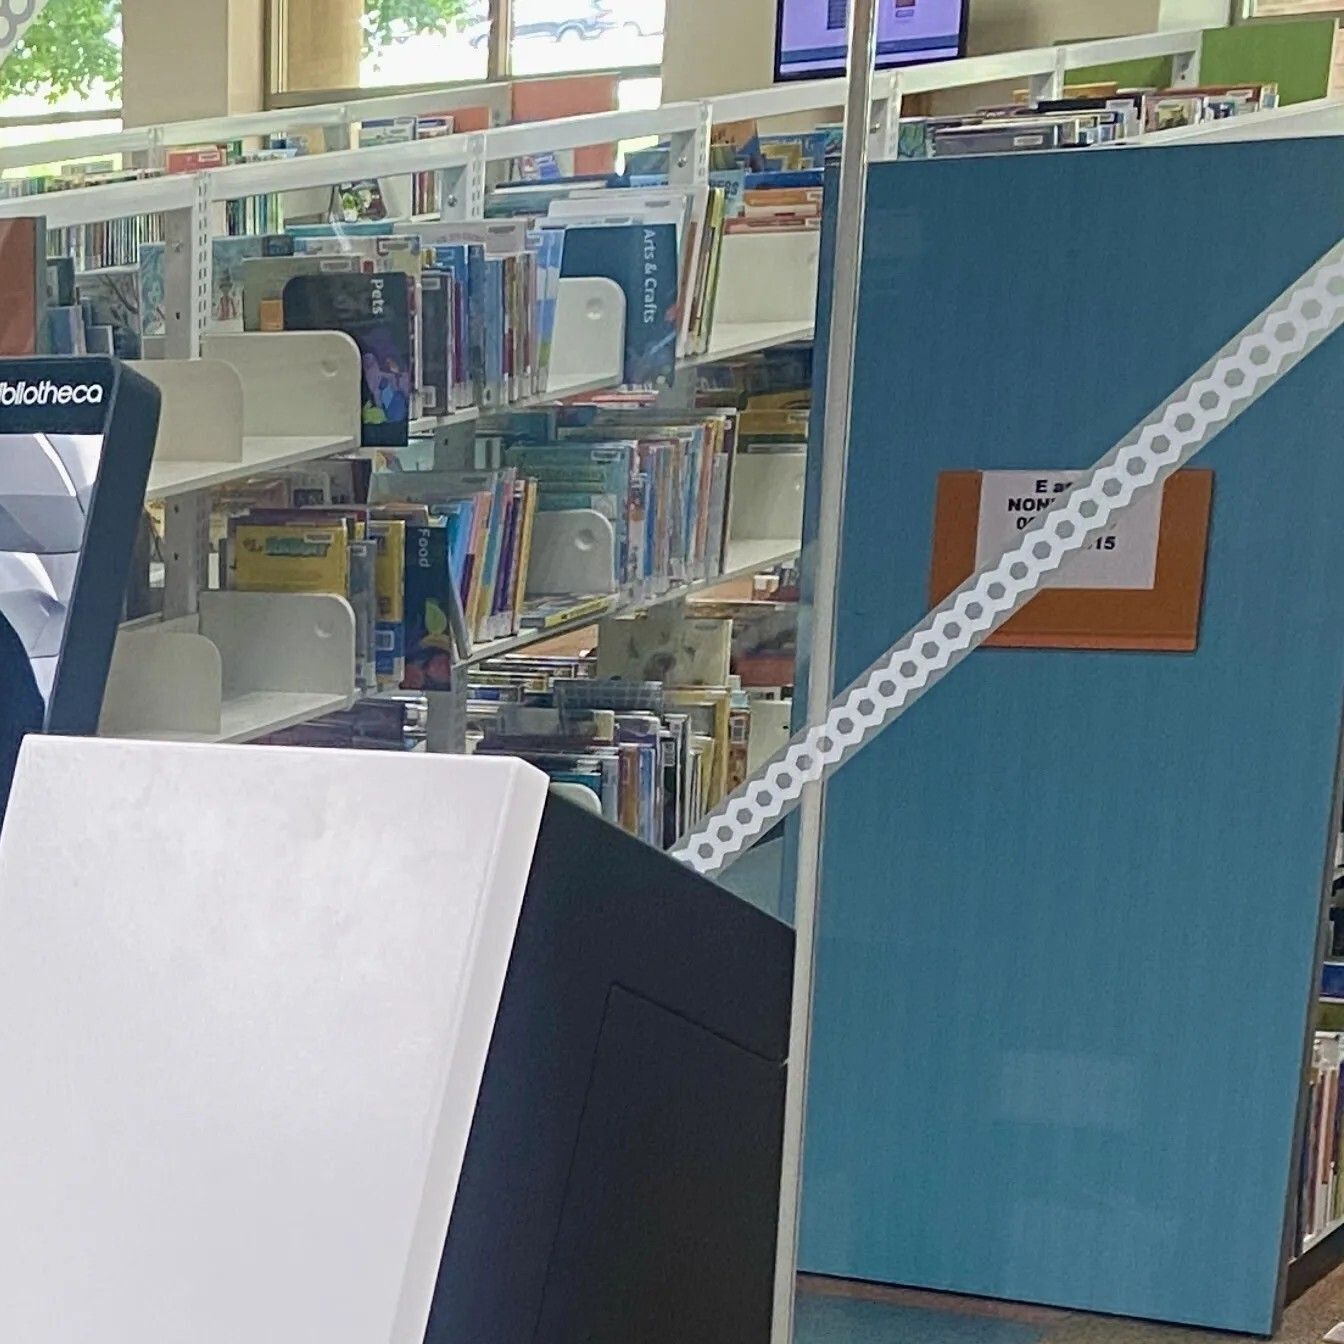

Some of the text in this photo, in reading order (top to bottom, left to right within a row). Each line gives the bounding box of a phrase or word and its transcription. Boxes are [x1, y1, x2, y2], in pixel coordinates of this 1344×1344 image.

[643, 229, 658, 323] Arts & Crafts
[370, 279, 384, 314] Pets
[417, 528, 431, 568] Food
